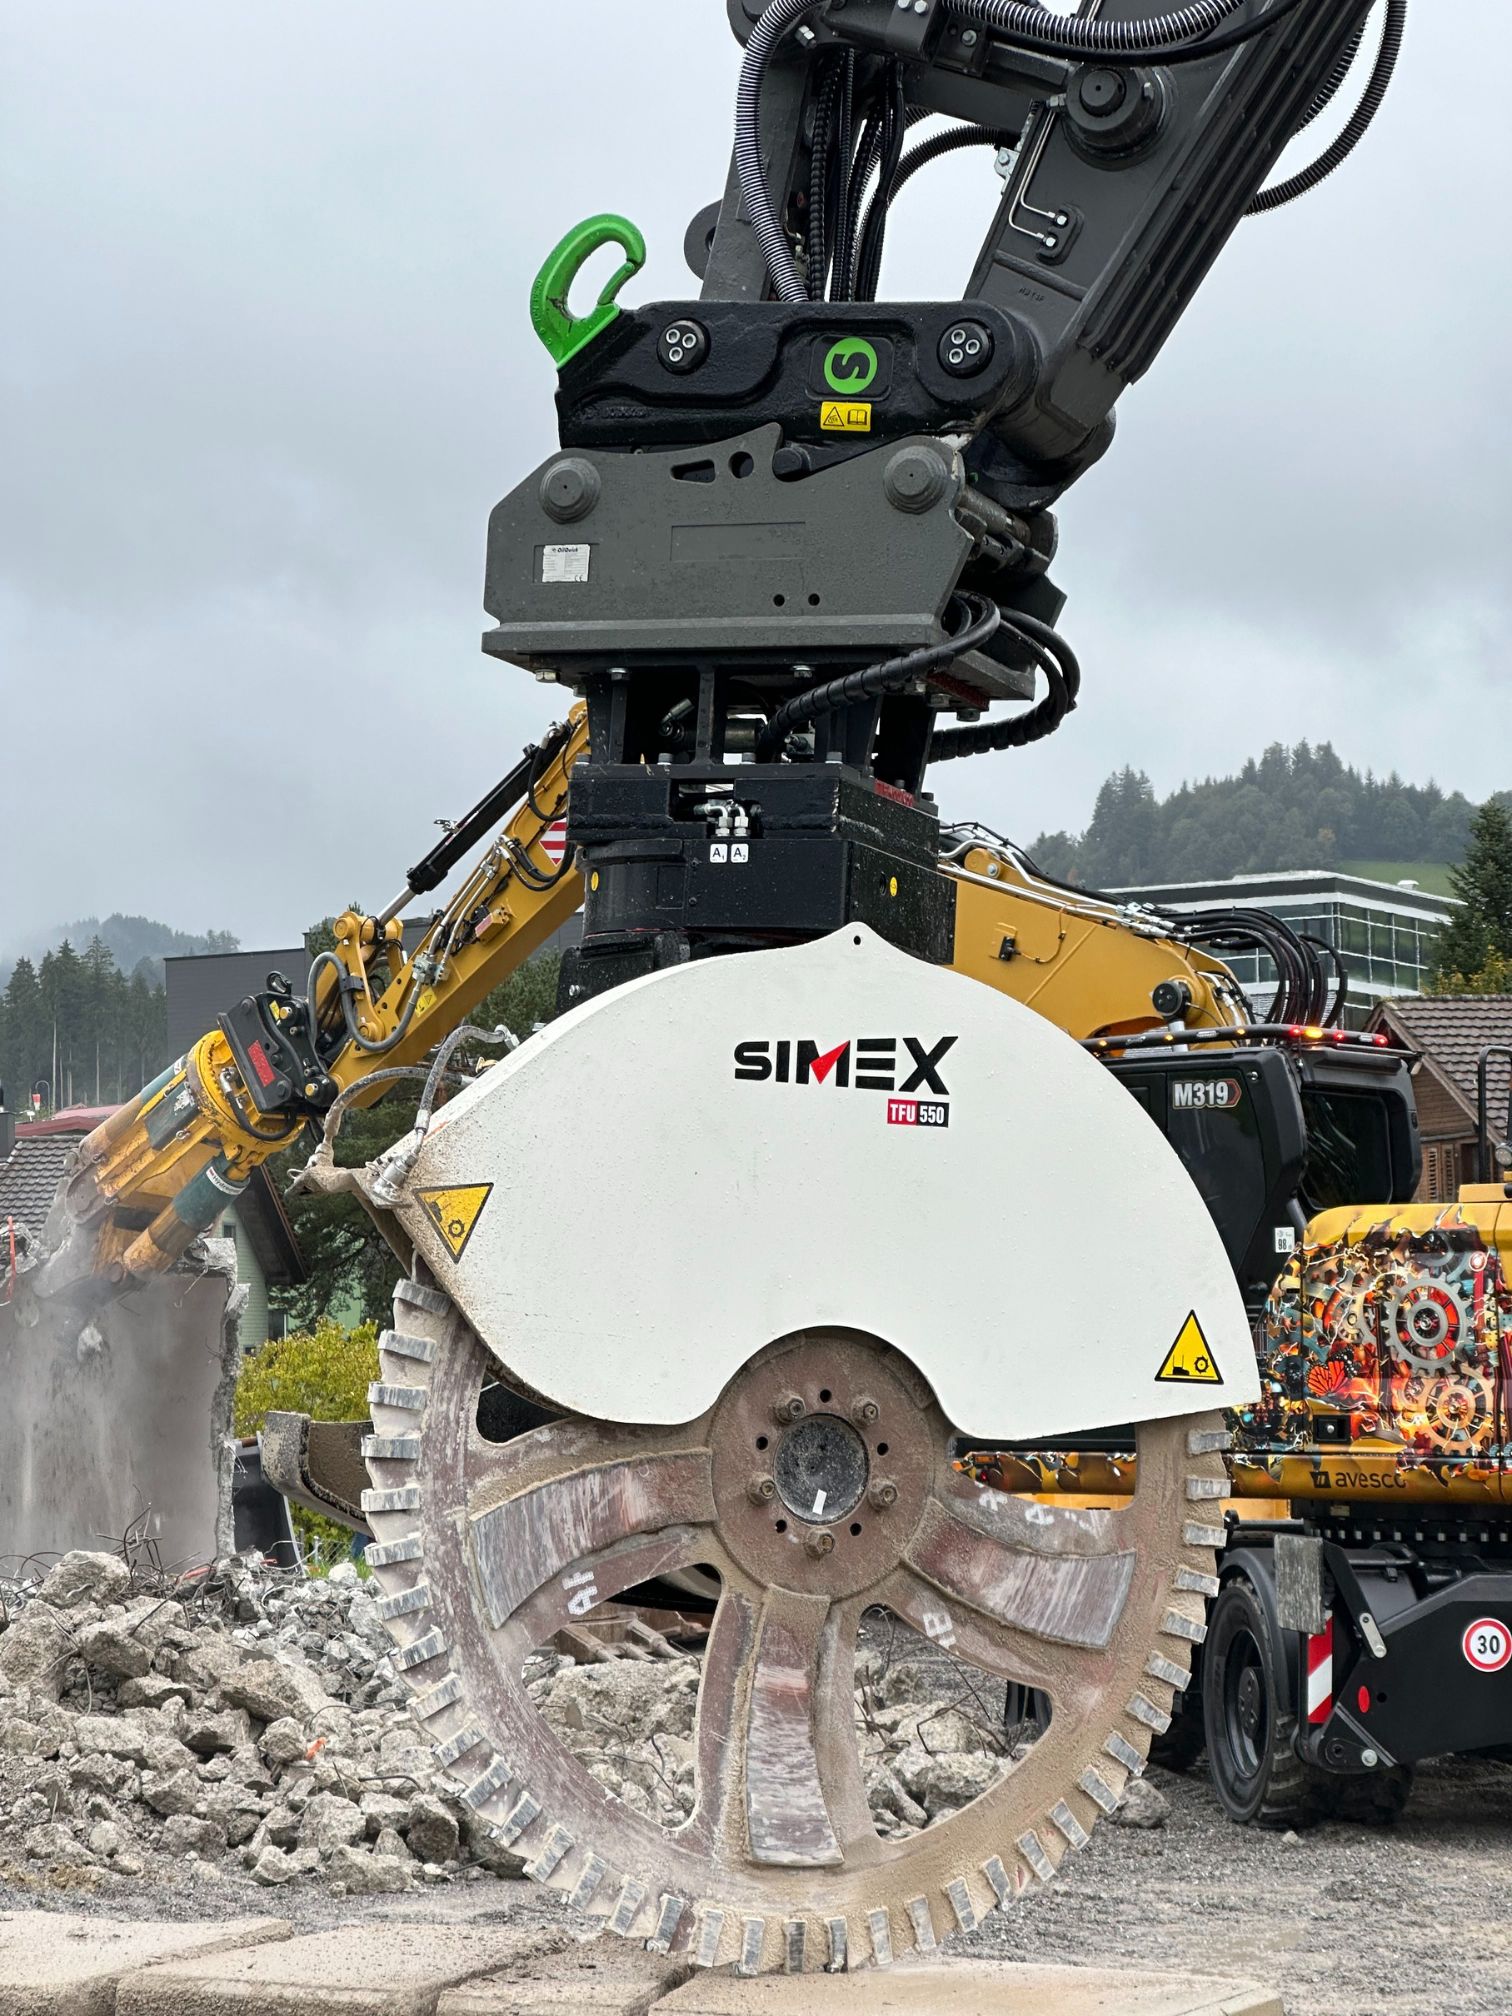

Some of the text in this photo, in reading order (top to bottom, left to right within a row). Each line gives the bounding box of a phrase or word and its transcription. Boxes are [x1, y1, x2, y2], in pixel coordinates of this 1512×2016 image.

[733, 1035, 959, 1095] SIMEX
[1174, 1081, 1228, 1106] M319
[889, 1103, 945, 1124] TFU 550
[1477, 1634, 1500, 1655] 30
